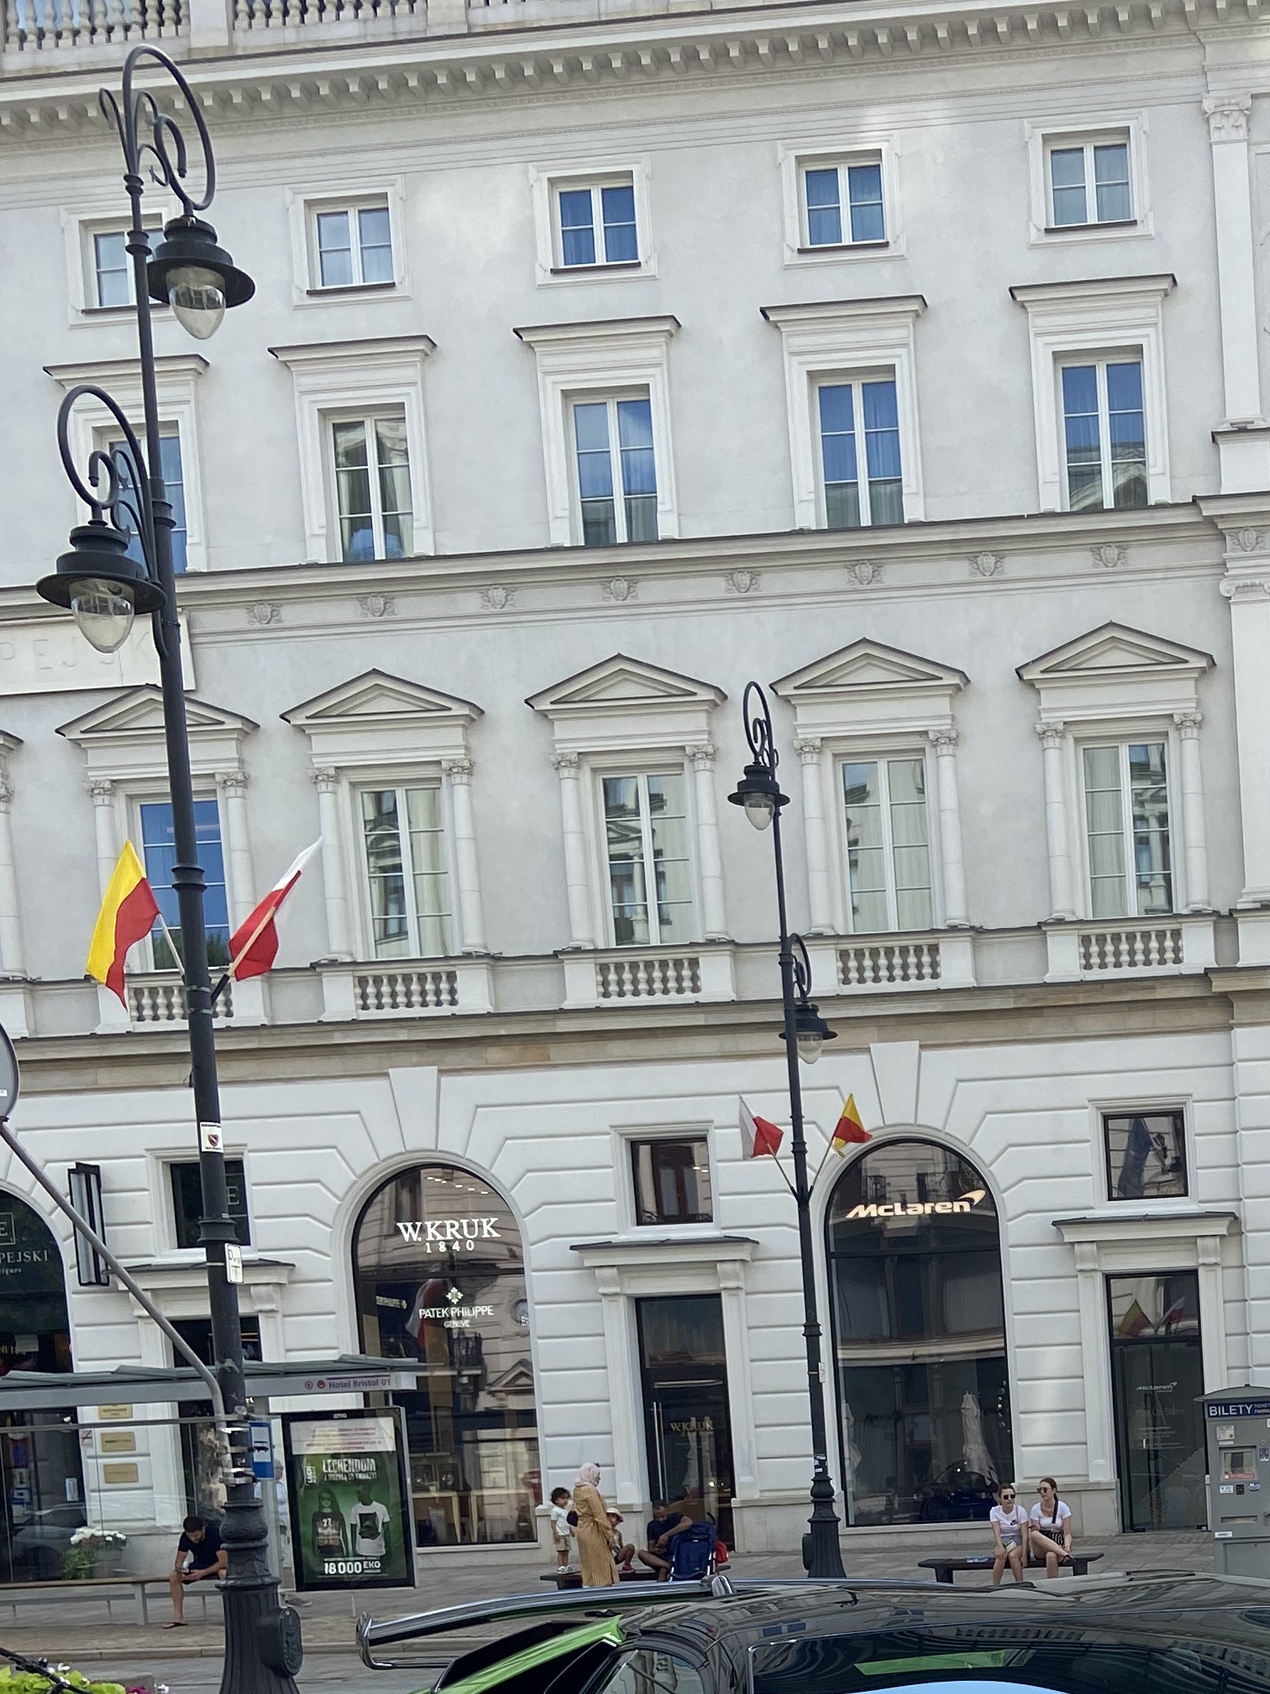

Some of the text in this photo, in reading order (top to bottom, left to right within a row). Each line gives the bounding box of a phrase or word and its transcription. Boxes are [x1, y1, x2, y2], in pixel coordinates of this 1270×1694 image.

[845, 1199, 972, 1219] McLaren
[396, 1217, 501, 1242] W.KRUK
[424, 1240, 475, 1254] 1840
[419, 1305, 494, 1319] PATEK PHILIPPE
[328, 1378, 391, 1389] Hotel Bristol 01
[1209, 1404, 1253, 1417] BILETY
